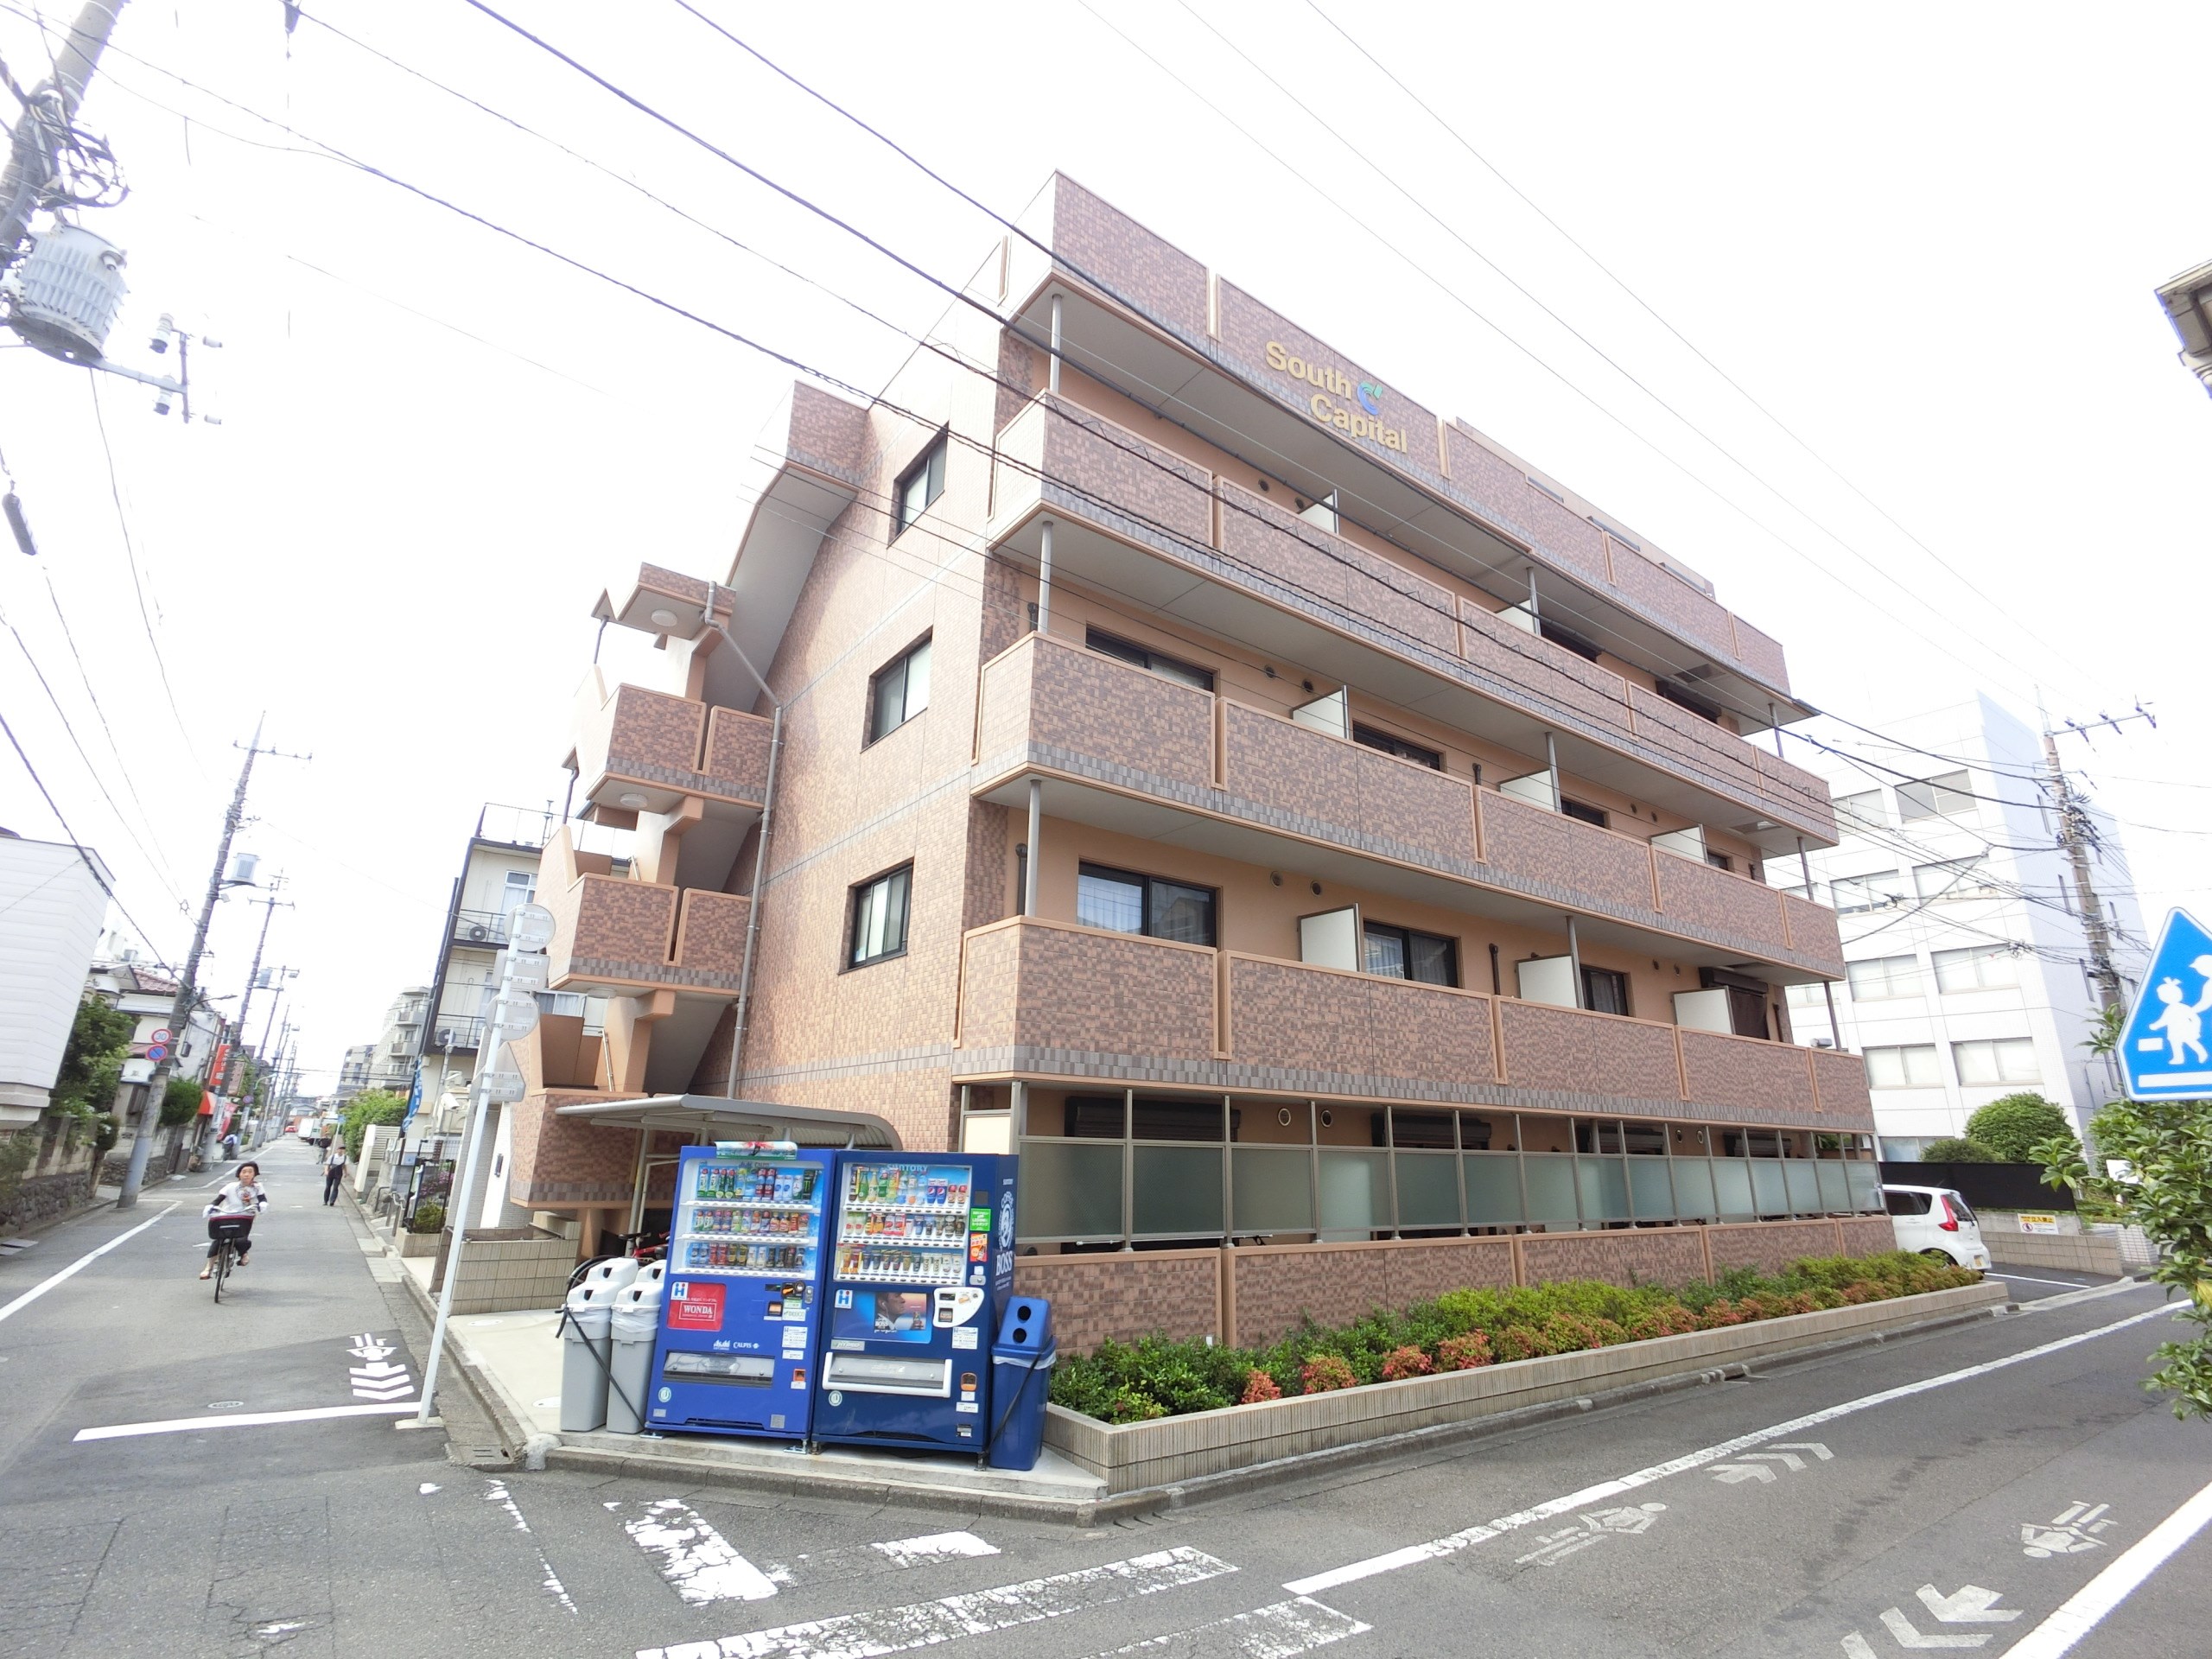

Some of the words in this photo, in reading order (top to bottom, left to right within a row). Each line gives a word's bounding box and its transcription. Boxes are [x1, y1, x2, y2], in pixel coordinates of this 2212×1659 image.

[1266, 340, 1351, 400] South
[1310, 394, 1408, 454] Capital
[995, 1250, 1013, 1276] BOSS
[683, 1305, 714, 1314] WONDA
